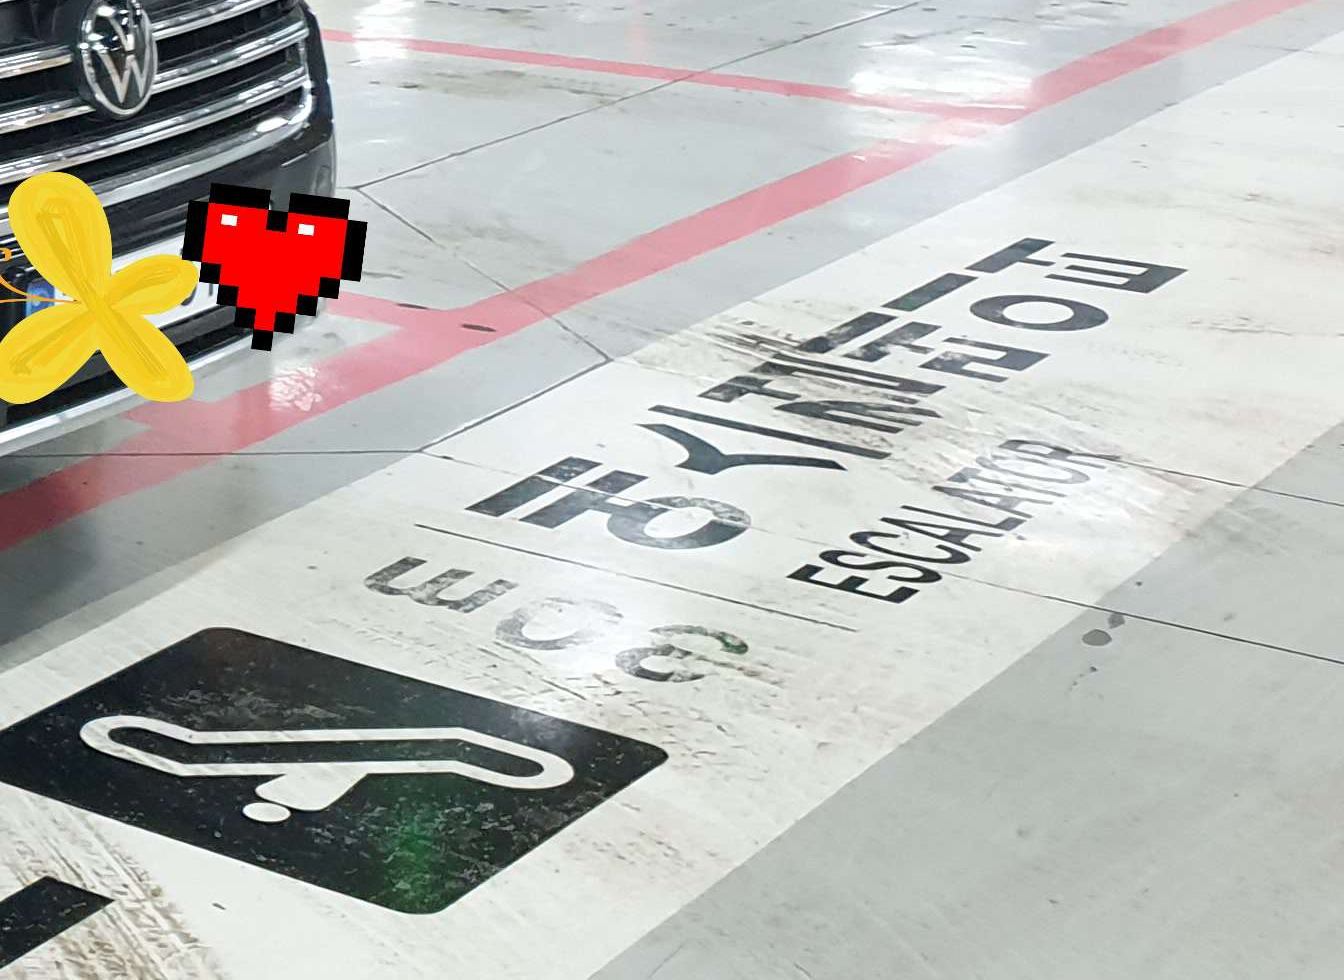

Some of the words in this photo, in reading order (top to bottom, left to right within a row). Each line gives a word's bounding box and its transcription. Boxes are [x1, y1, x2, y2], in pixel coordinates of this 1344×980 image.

[465, 237, 1188, 551] 에스컬레이터
[786, 439, 1102, 604] ESCALATOR
[363, 556, 748, 684] 30m
